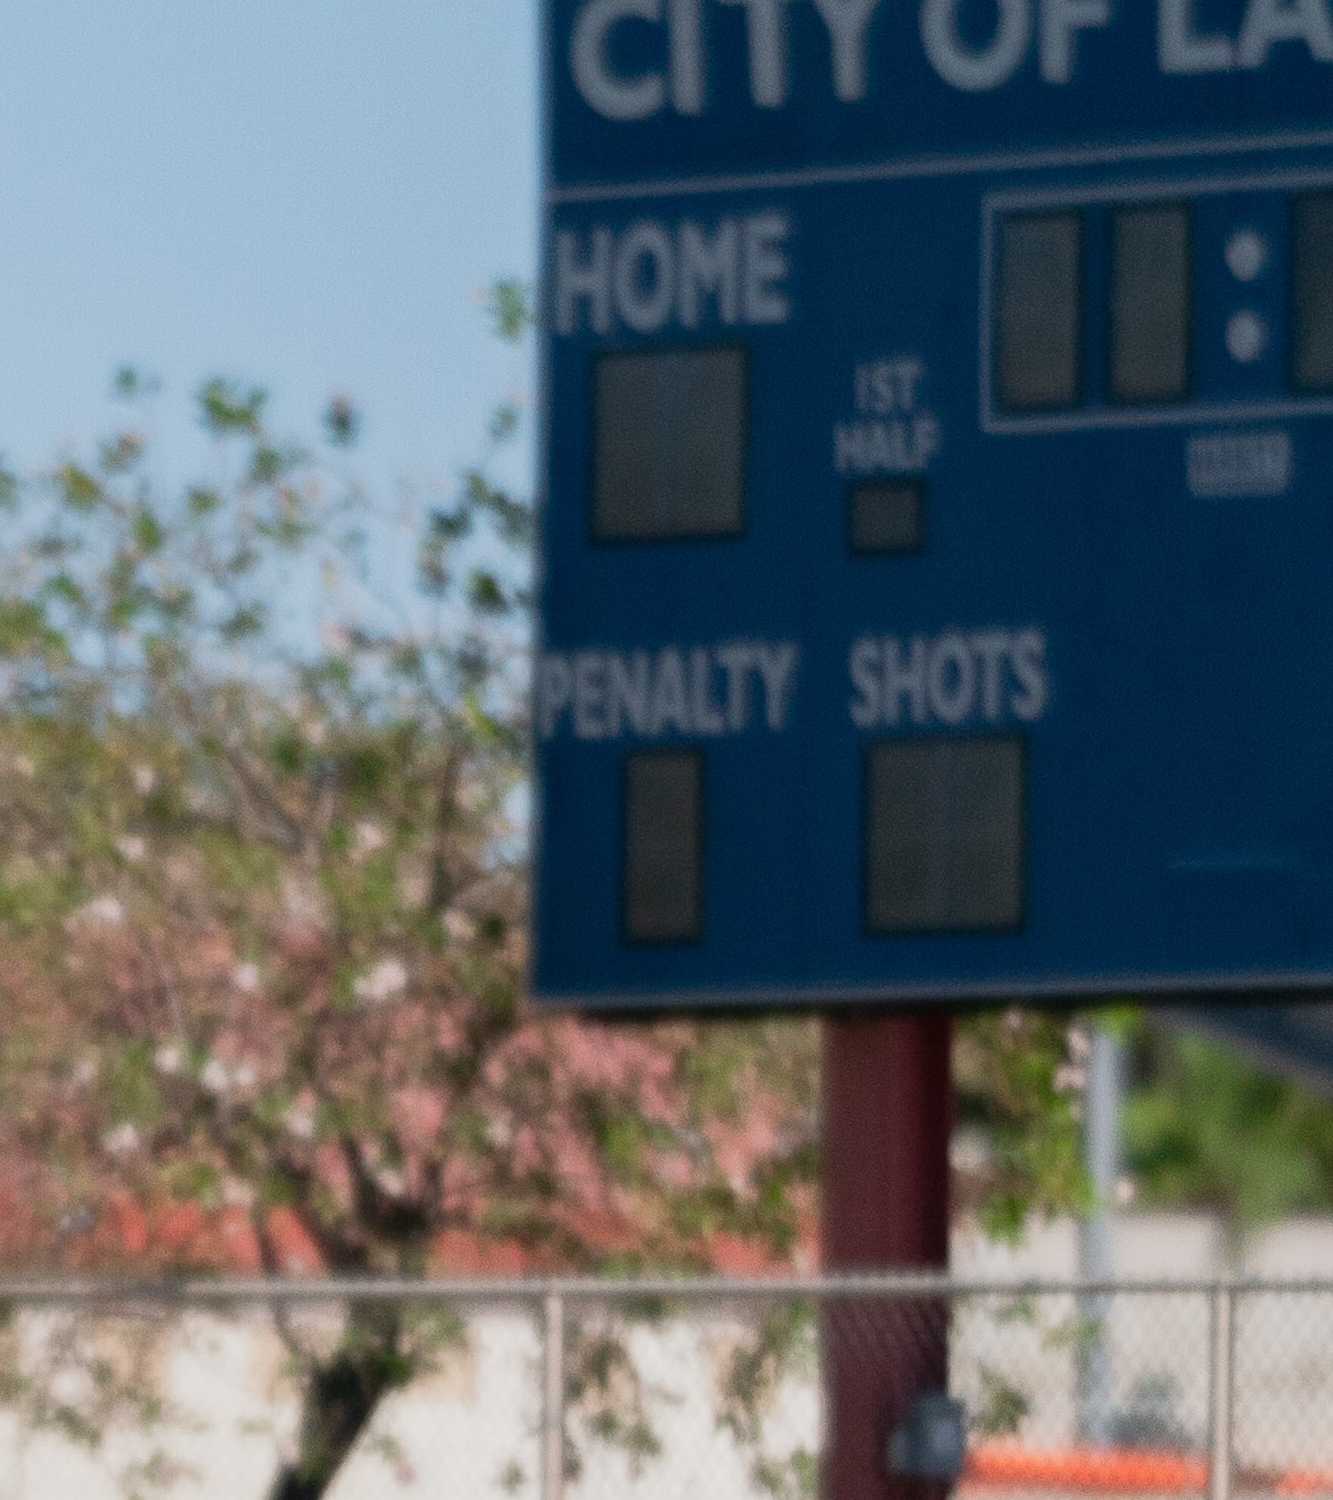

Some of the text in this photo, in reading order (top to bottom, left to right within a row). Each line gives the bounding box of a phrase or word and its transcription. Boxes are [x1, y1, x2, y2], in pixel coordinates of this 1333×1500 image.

[554, 212, 791, 336] HOME
[834, 415, 940, 470] HALF
[536, 627, 1049, 739] PENALTY SHOTS
